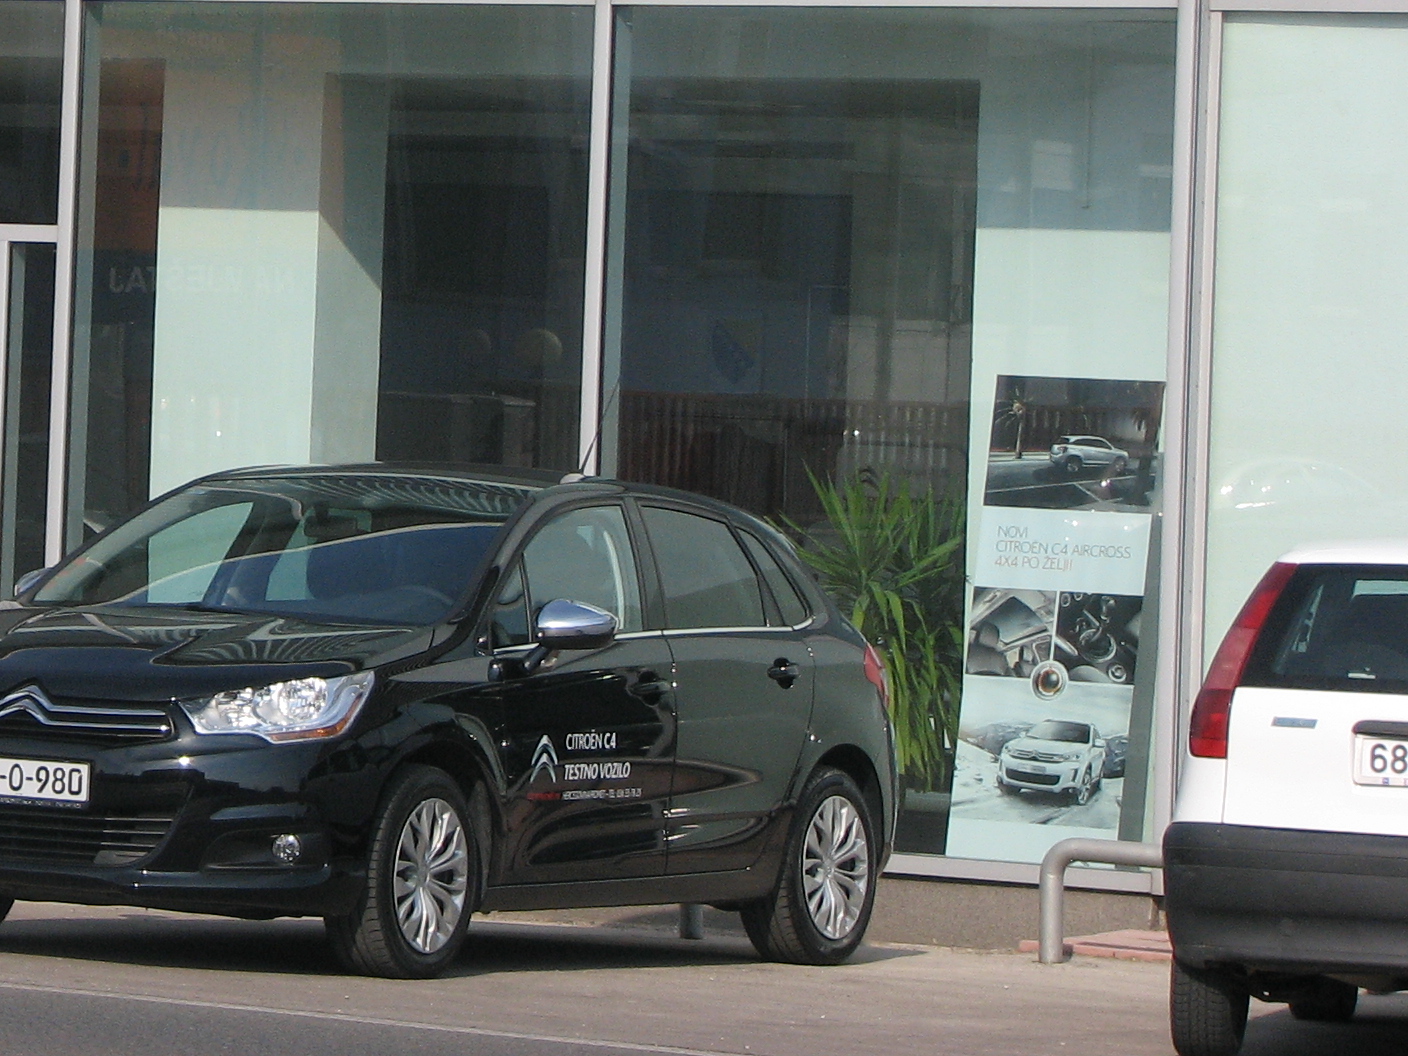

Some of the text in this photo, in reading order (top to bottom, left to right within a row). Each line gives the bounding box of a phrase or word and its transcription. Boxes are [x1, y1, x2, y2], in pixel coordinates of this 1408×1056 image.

[997, 525, 1028, 539] NOVI
[1051, 542, 1069, 556] C4
[1071, 544, 1132, 559] AIRCROSS
[1021, 555, 1040, 570] PO
[603, 732, 617, 749] C4
[1369, 743, 1408, 774] 68
[564, 761, 631, 781] TESTNO VOZILO
